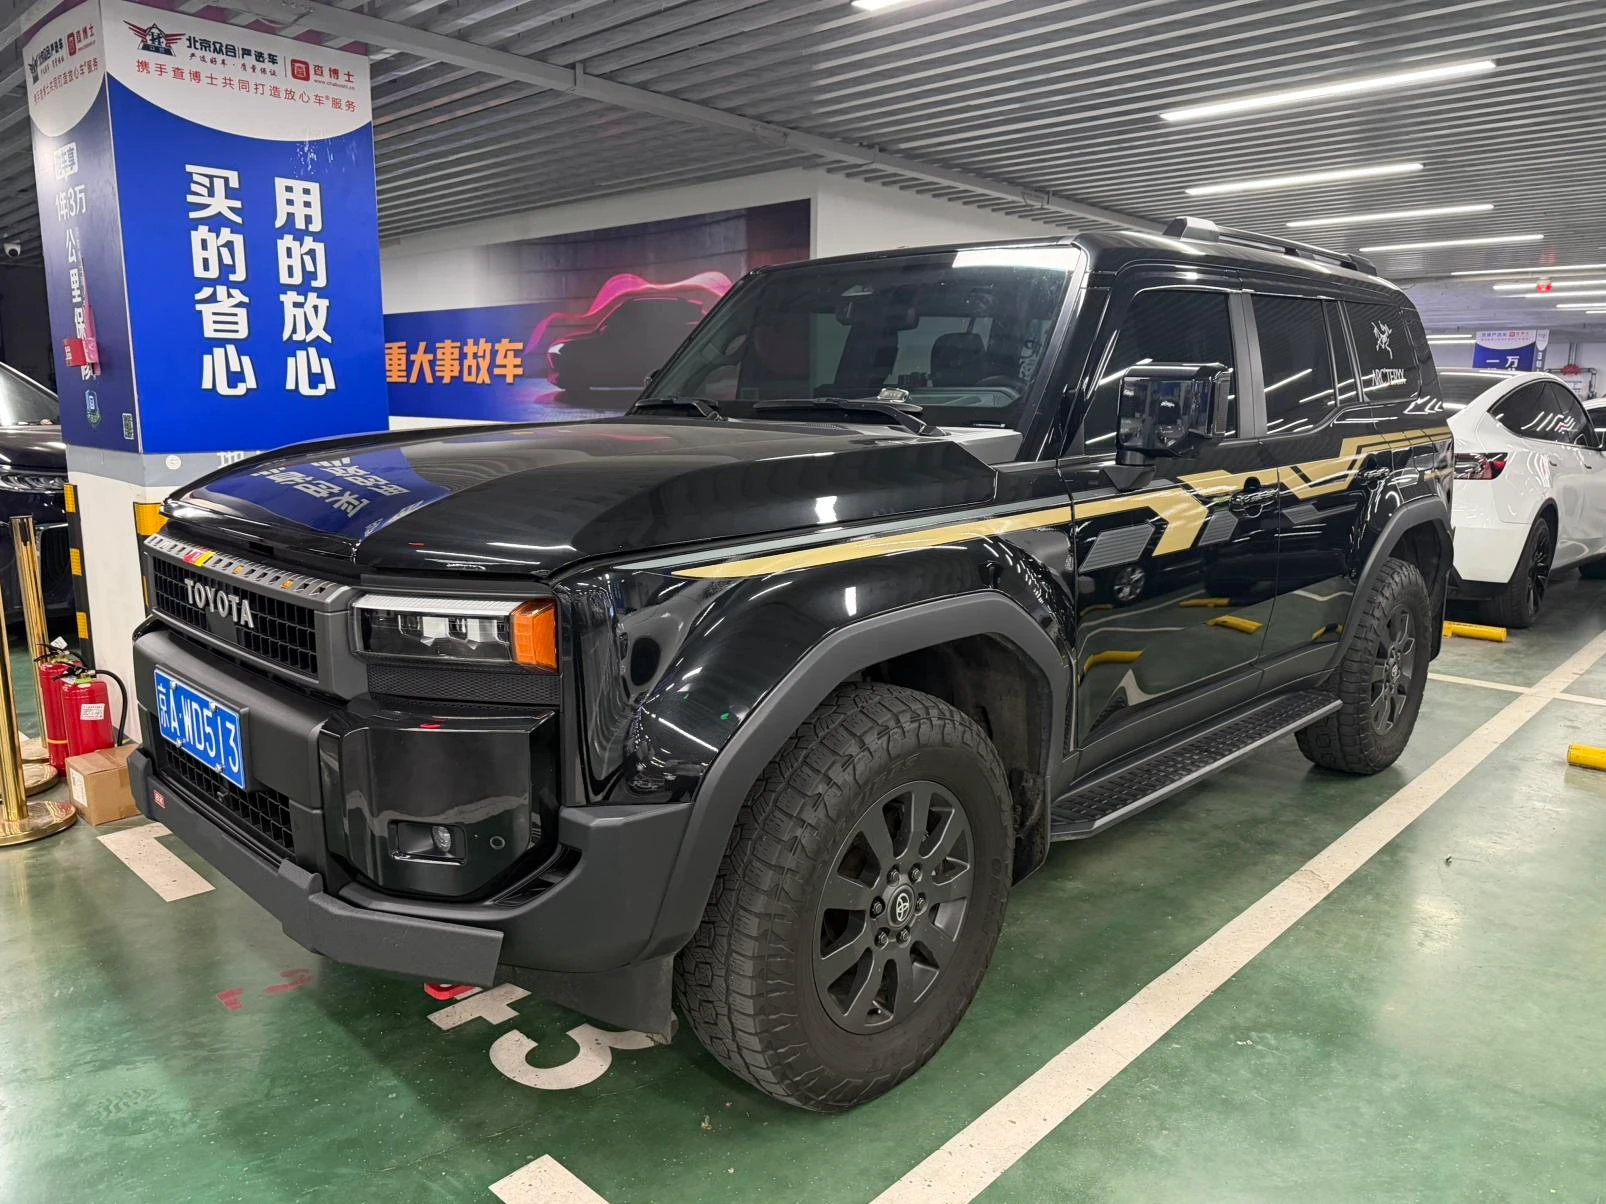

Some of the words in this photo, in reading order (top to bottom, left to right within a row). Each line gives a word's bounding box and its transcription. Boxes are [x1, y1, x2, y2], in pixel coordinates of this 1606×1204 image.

[185, 163, 258, 397] 买的省心
[274, 176, 337, 397] 用的放心
[384, 338, 525, 386] 重大事故车
[184, 578, 255, 629] TOYOTA
